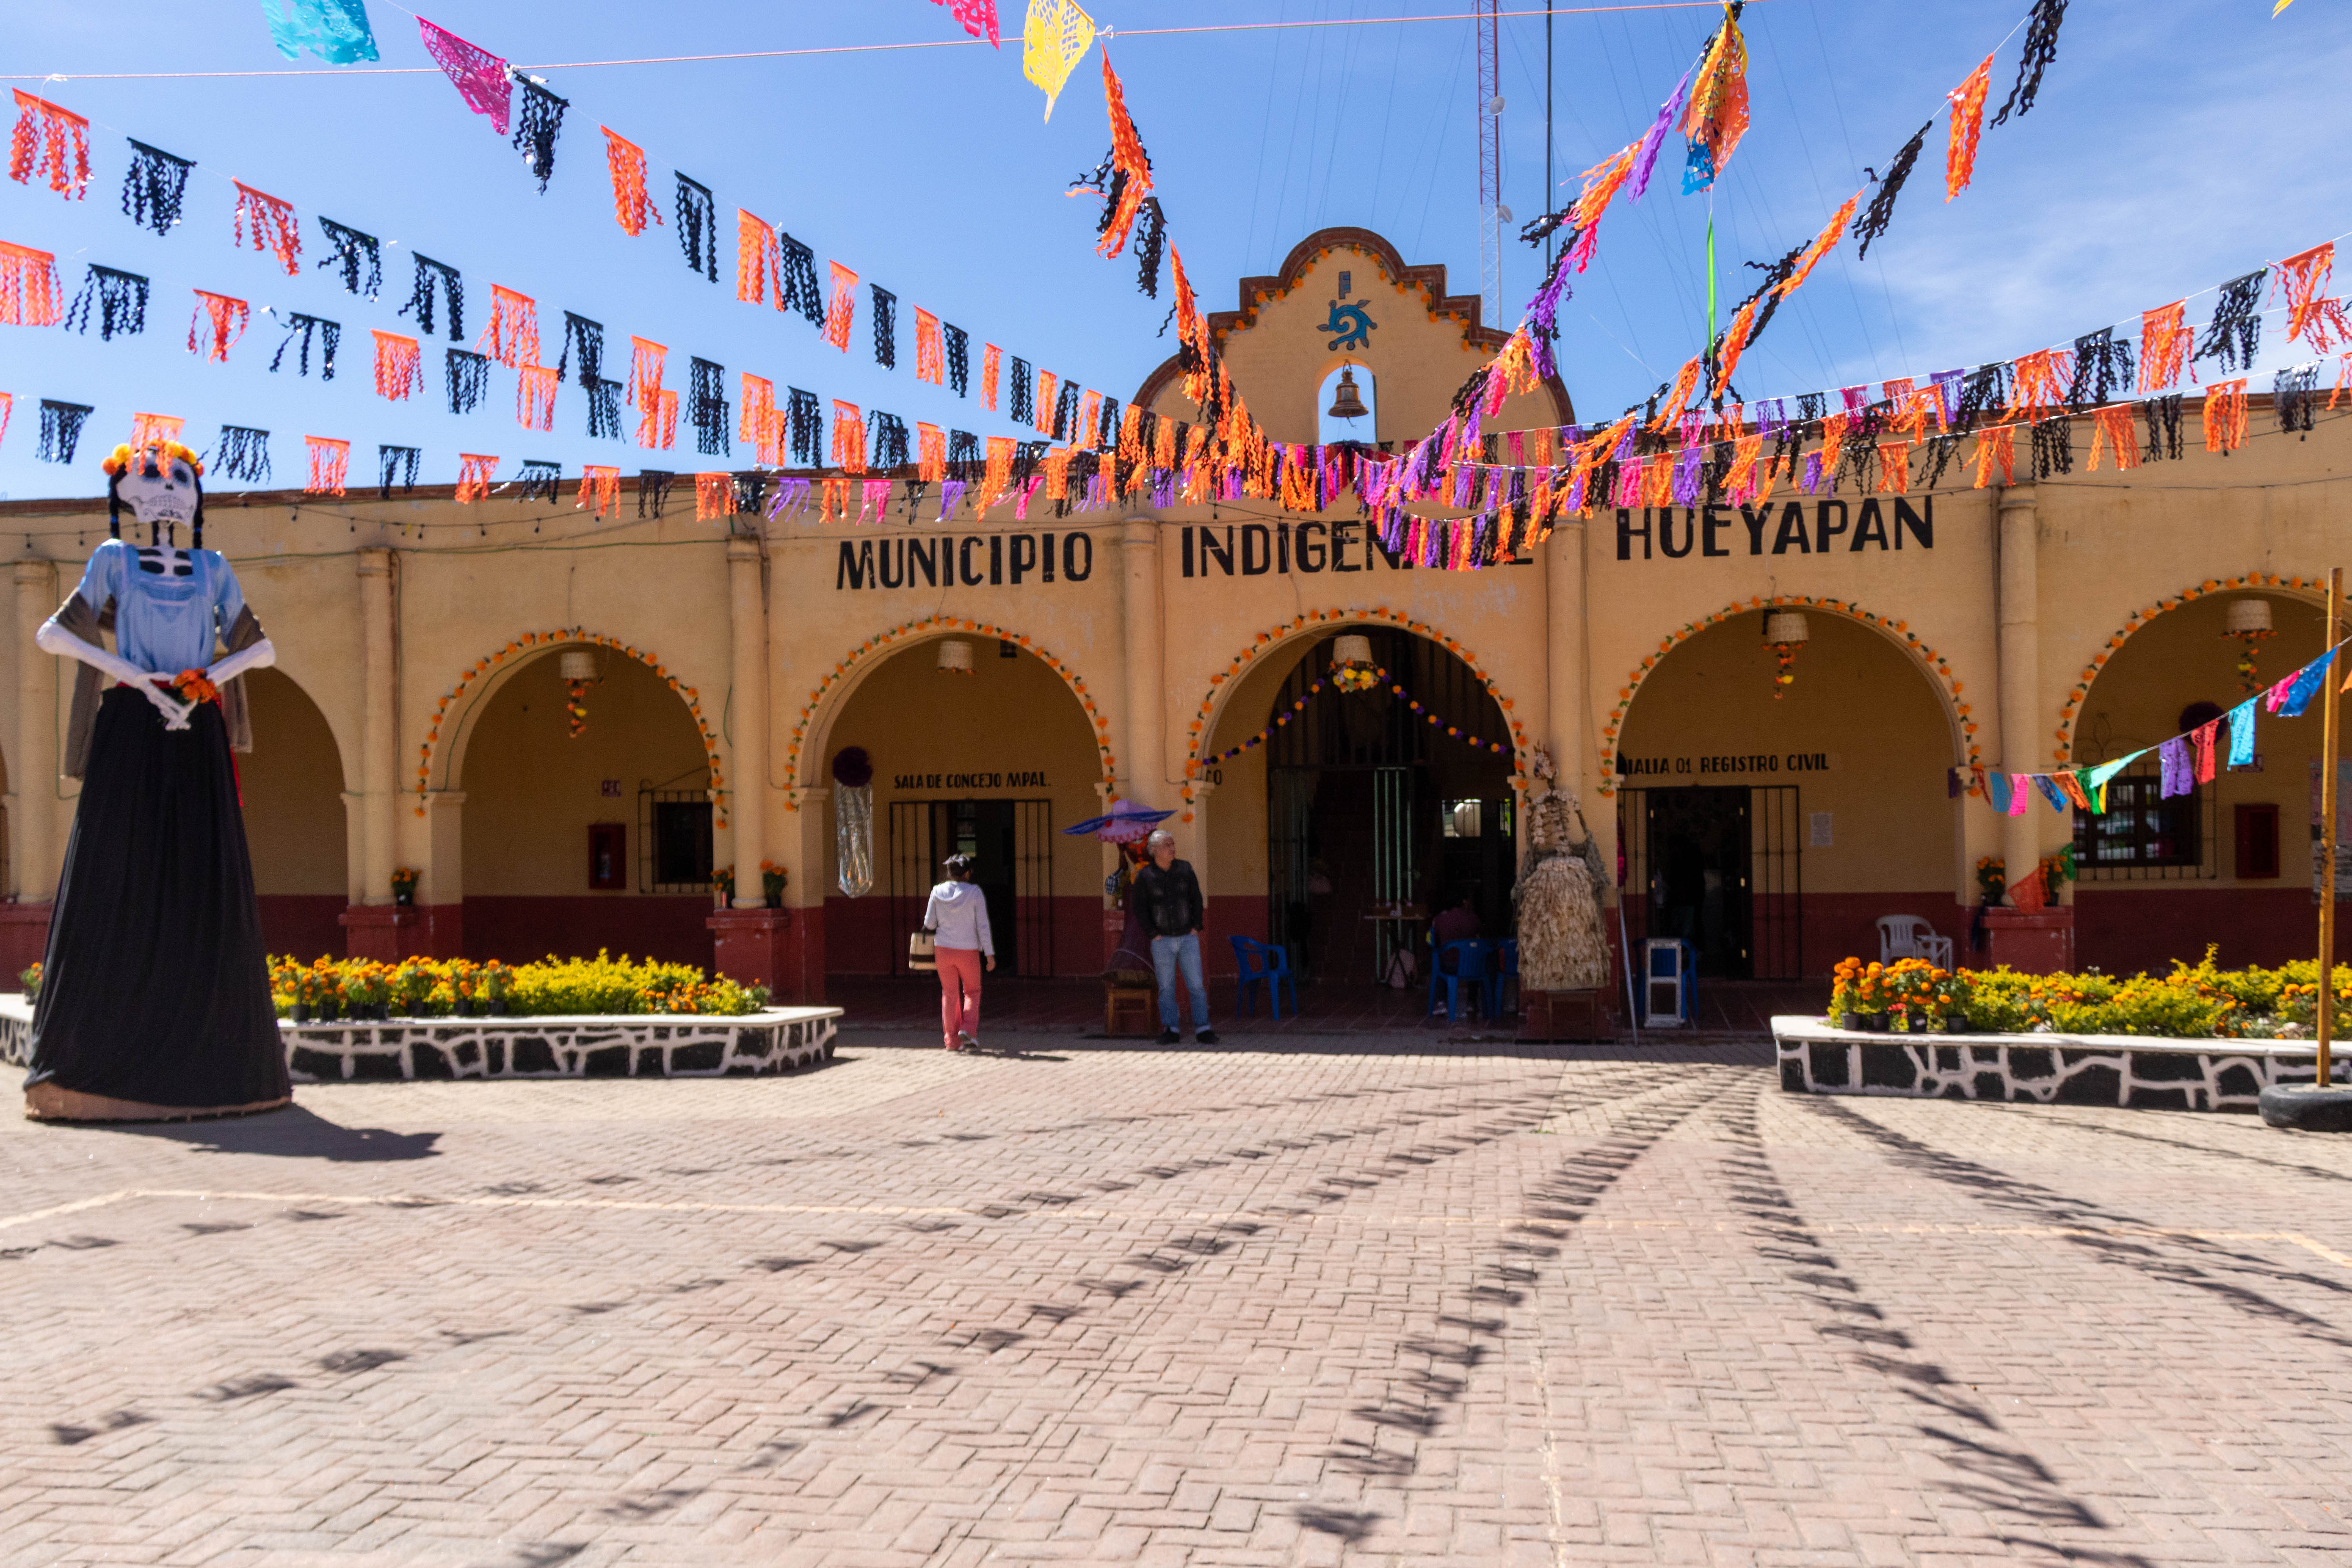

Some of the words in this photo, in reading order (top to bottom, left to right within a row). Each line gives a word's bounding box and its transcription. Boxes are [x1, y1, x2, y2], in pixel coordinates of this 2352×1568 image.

[837, 532, 1092, 590] MUNICIPIO
[1182, 520, 1446, 577] INDIGEN
[1617, 495, 1933, 560] HUEYAPAN
[1628, 758, 1670, 774] IALIA
[1700, 755, 1778, 773] REGISTRO
[1787, 753, 1829, 771] CIVIL
[894, 774, 923, 789] SALA
[926, 774, 942, 789] DE
[946, 772, 1001, 788] CONCEJO
